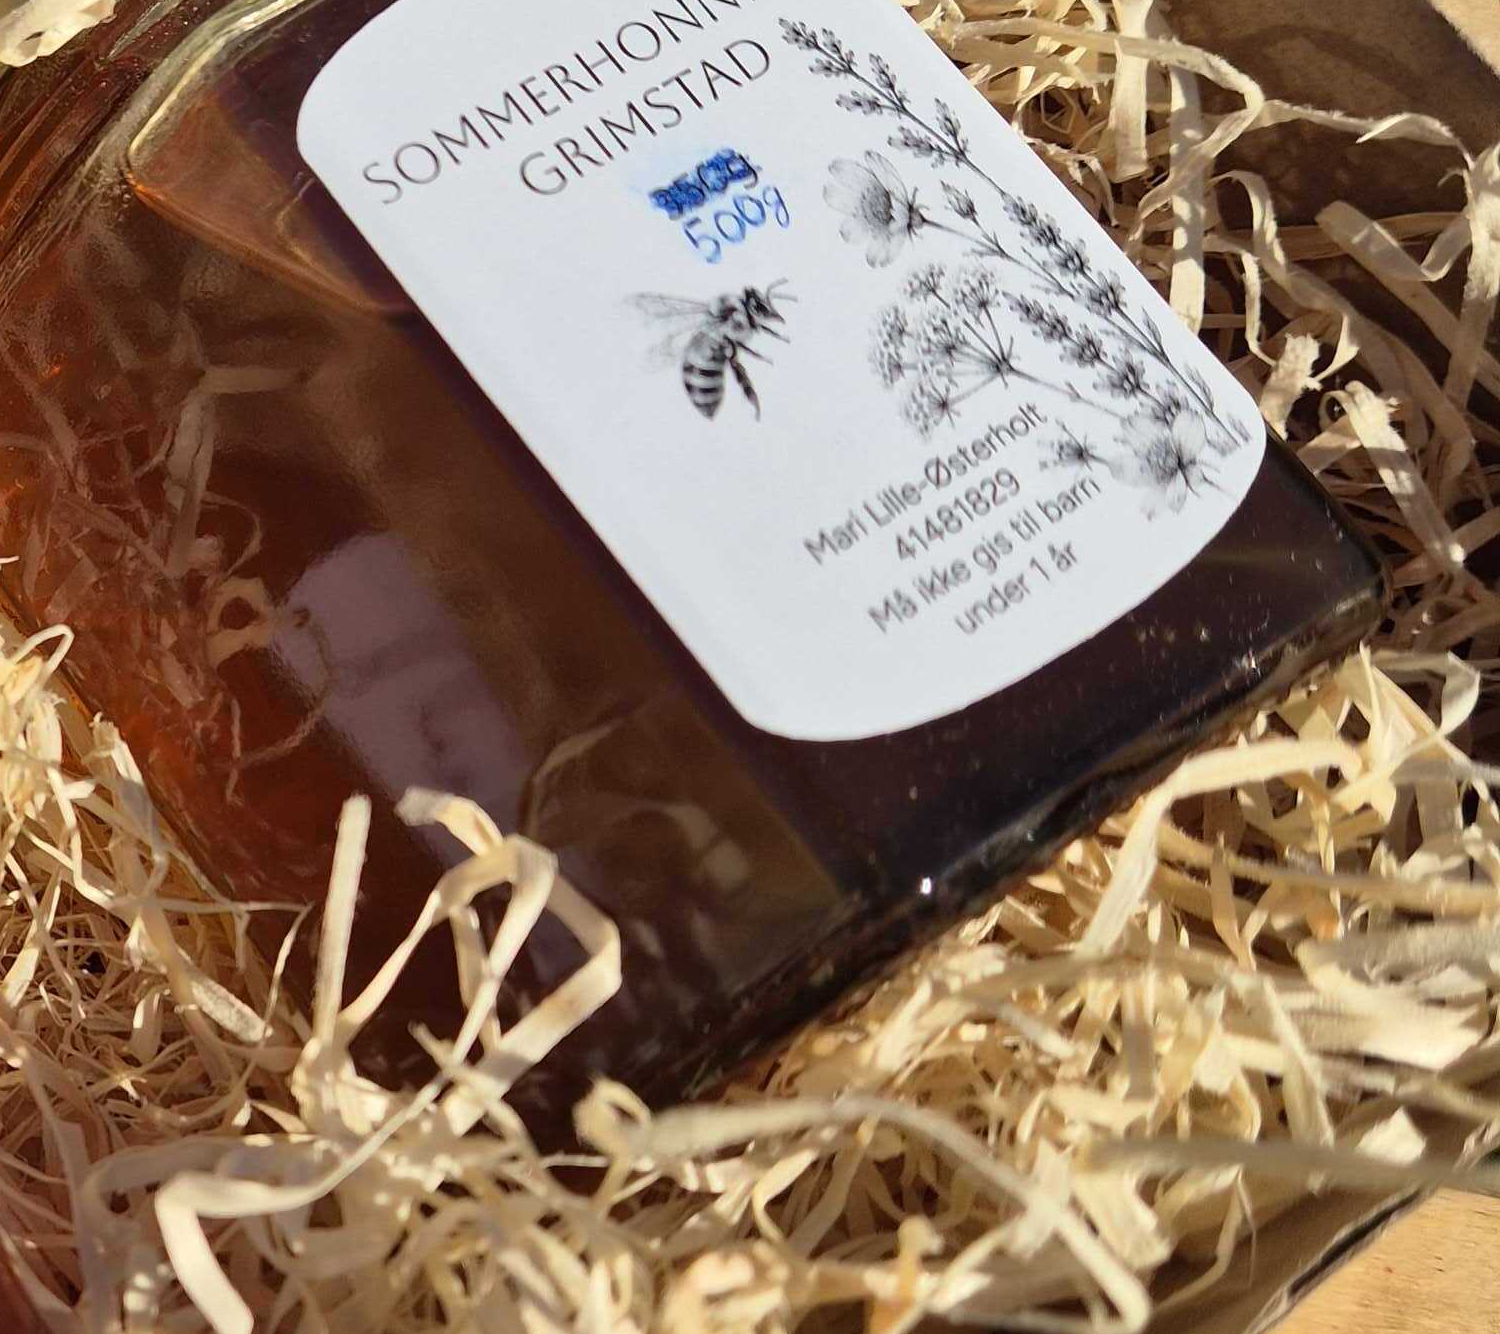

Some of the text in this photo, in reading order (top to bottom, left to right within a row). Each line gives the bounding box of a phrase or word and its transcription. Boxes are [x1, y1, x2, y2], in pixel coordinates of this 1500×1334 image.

[520, 39, 771, 195] GRIMSTAD
[683, 186, 790, 264] 500g
[803, 403, 1047, 565] Mari Lille-Østerholt
[896, 468, 1020, 560] 41481829
[868, 477, 1101, 633] Må ikke gis til barn
[955, 541, 1078, 634] under 1 år
